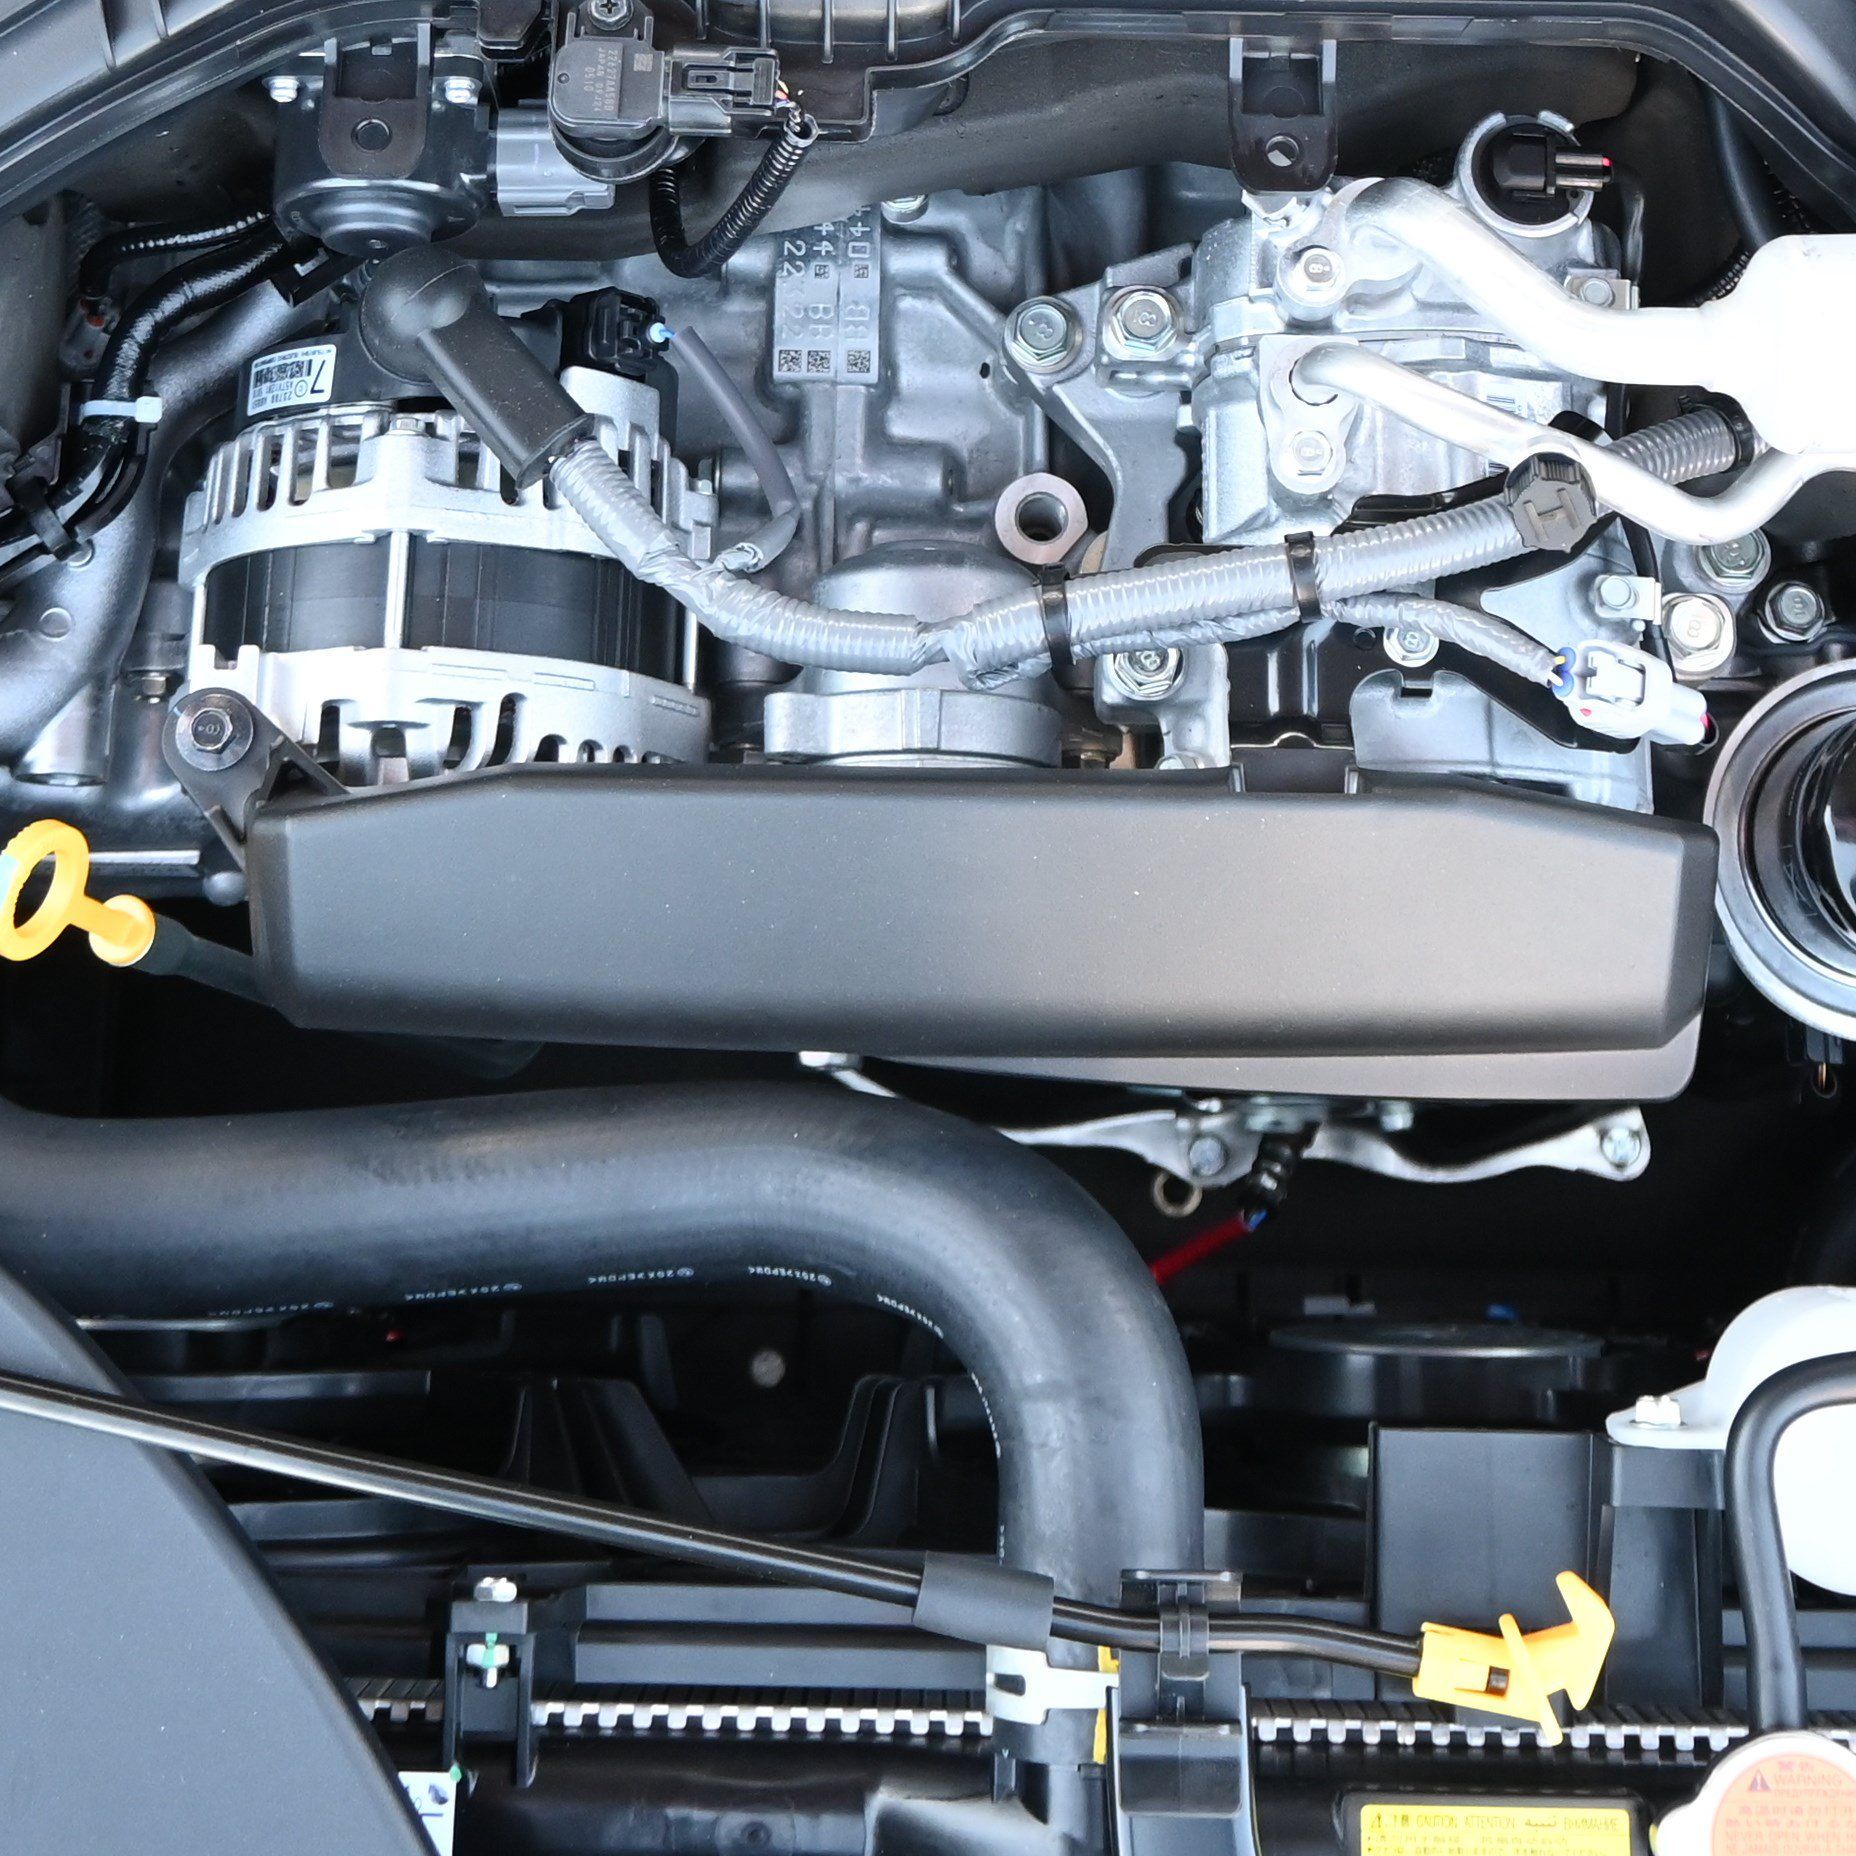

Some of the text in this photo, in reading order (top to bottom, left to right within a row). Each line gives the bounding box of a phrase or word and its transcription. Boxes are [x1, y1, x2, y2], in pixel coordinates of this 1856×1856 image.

[310, 359, 326, 394] 7
[1773, 1774, 1843, 1786] WARNING
[1415, 1815, 1458, 1828] CAUTION
[1464, 1816, 1515, 1829] ATTENTION
[1726, 1831, 1763, 1841] NEVER
[1769, 1831, 1802, 1841] OPEN
[1806, 1831, 1841, 1841] WHEN
